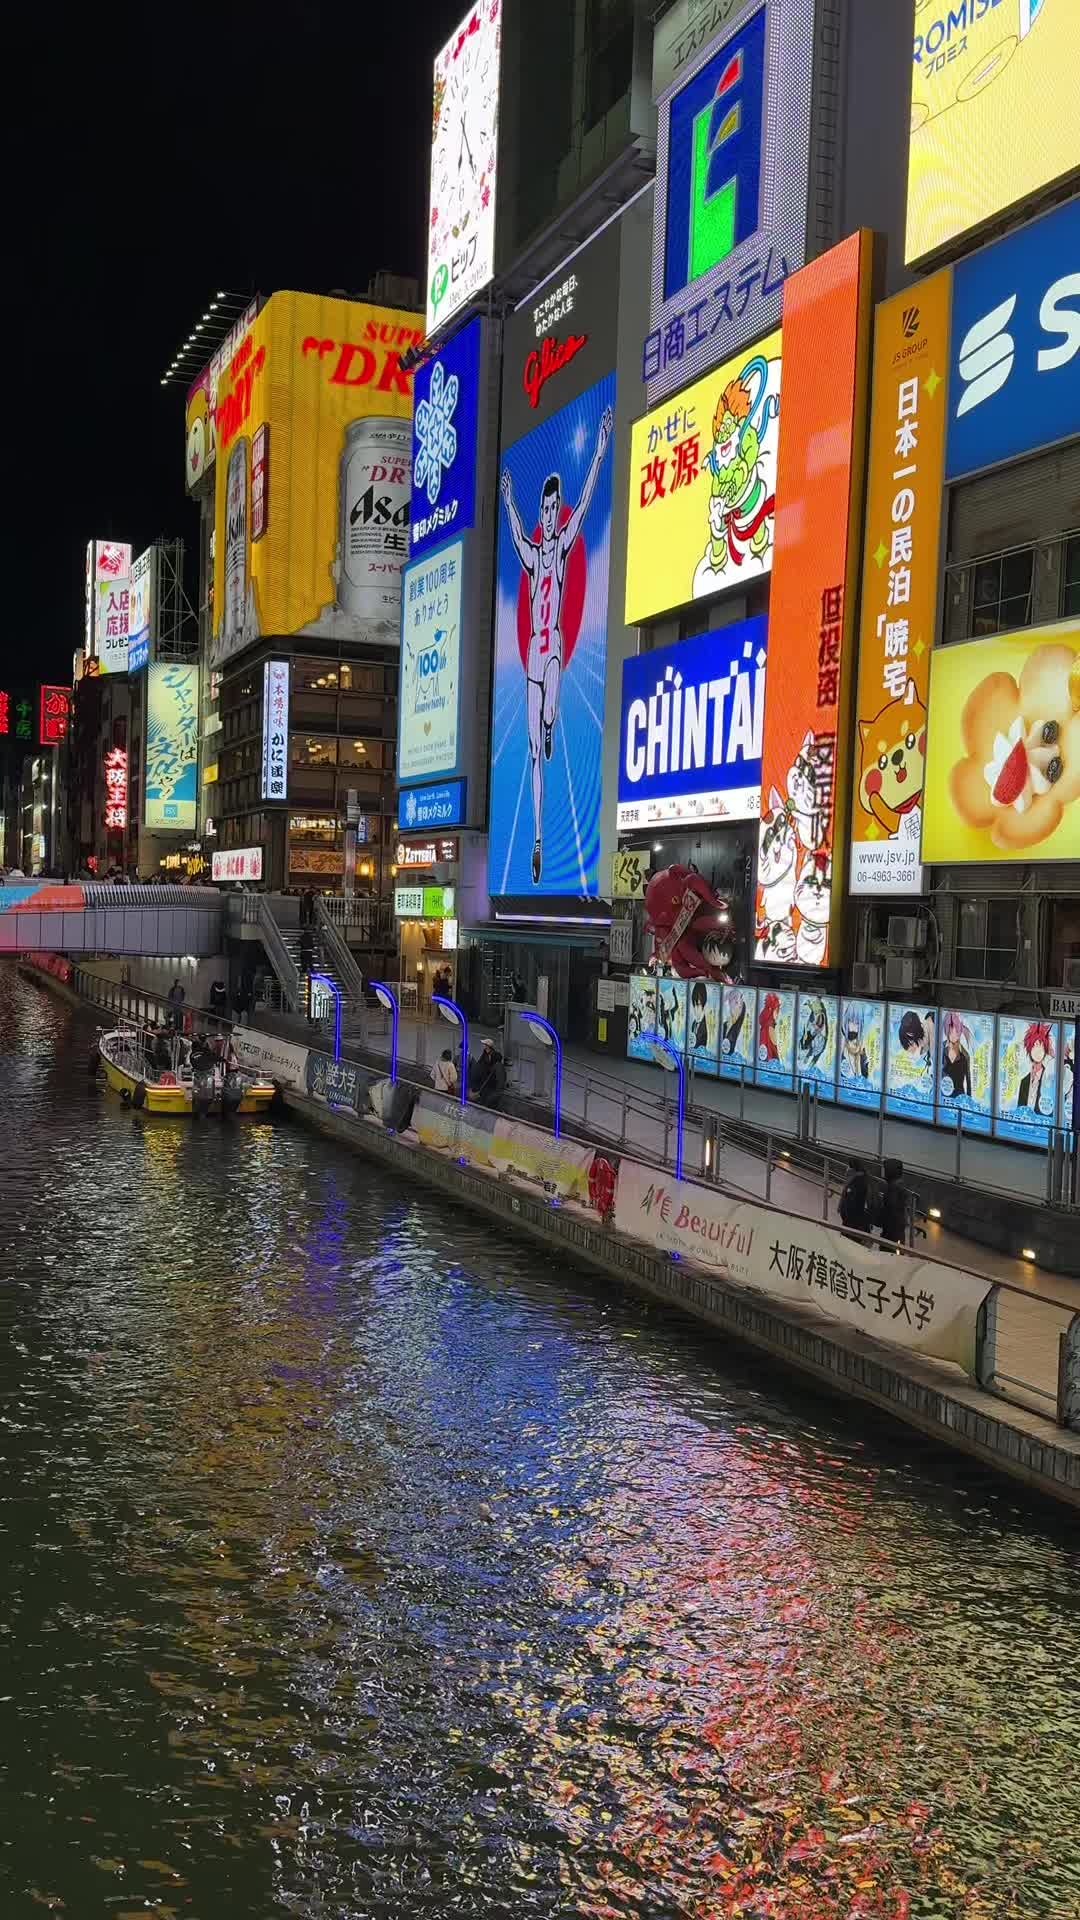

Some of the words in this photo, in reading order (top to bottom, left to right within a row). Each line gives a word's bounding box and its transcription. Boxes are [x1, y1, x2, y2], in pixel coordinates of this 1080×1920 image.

[924, 35, 968, 79] プロミス
[641, 246, 789, 384] 日商エステム
[901, 338, 928, 360] GROUP
[523, 335, 588, 409] Glico
[646, 405, 697, 453] かぜに
[640, 432, 702, 509] 改源
[384, 534, 408, 551] 生
[412, 499, 459, 544] 雪印メグミルク
[106, 589, 129, 613] 入店
[414, 593, 450, 627] ありがとう
[540, 569, 553, 657] グリコ
[626, 652, 767, 784] CHINTAI
[857, 870, 916, 883] 06-4963-3661
[859, 849, 916, 866] www.jsv.jp
[1051, 999, 1075, 1014] BAR
[768, 1238, 936, 1332] 大阪樟蔭女子大学
